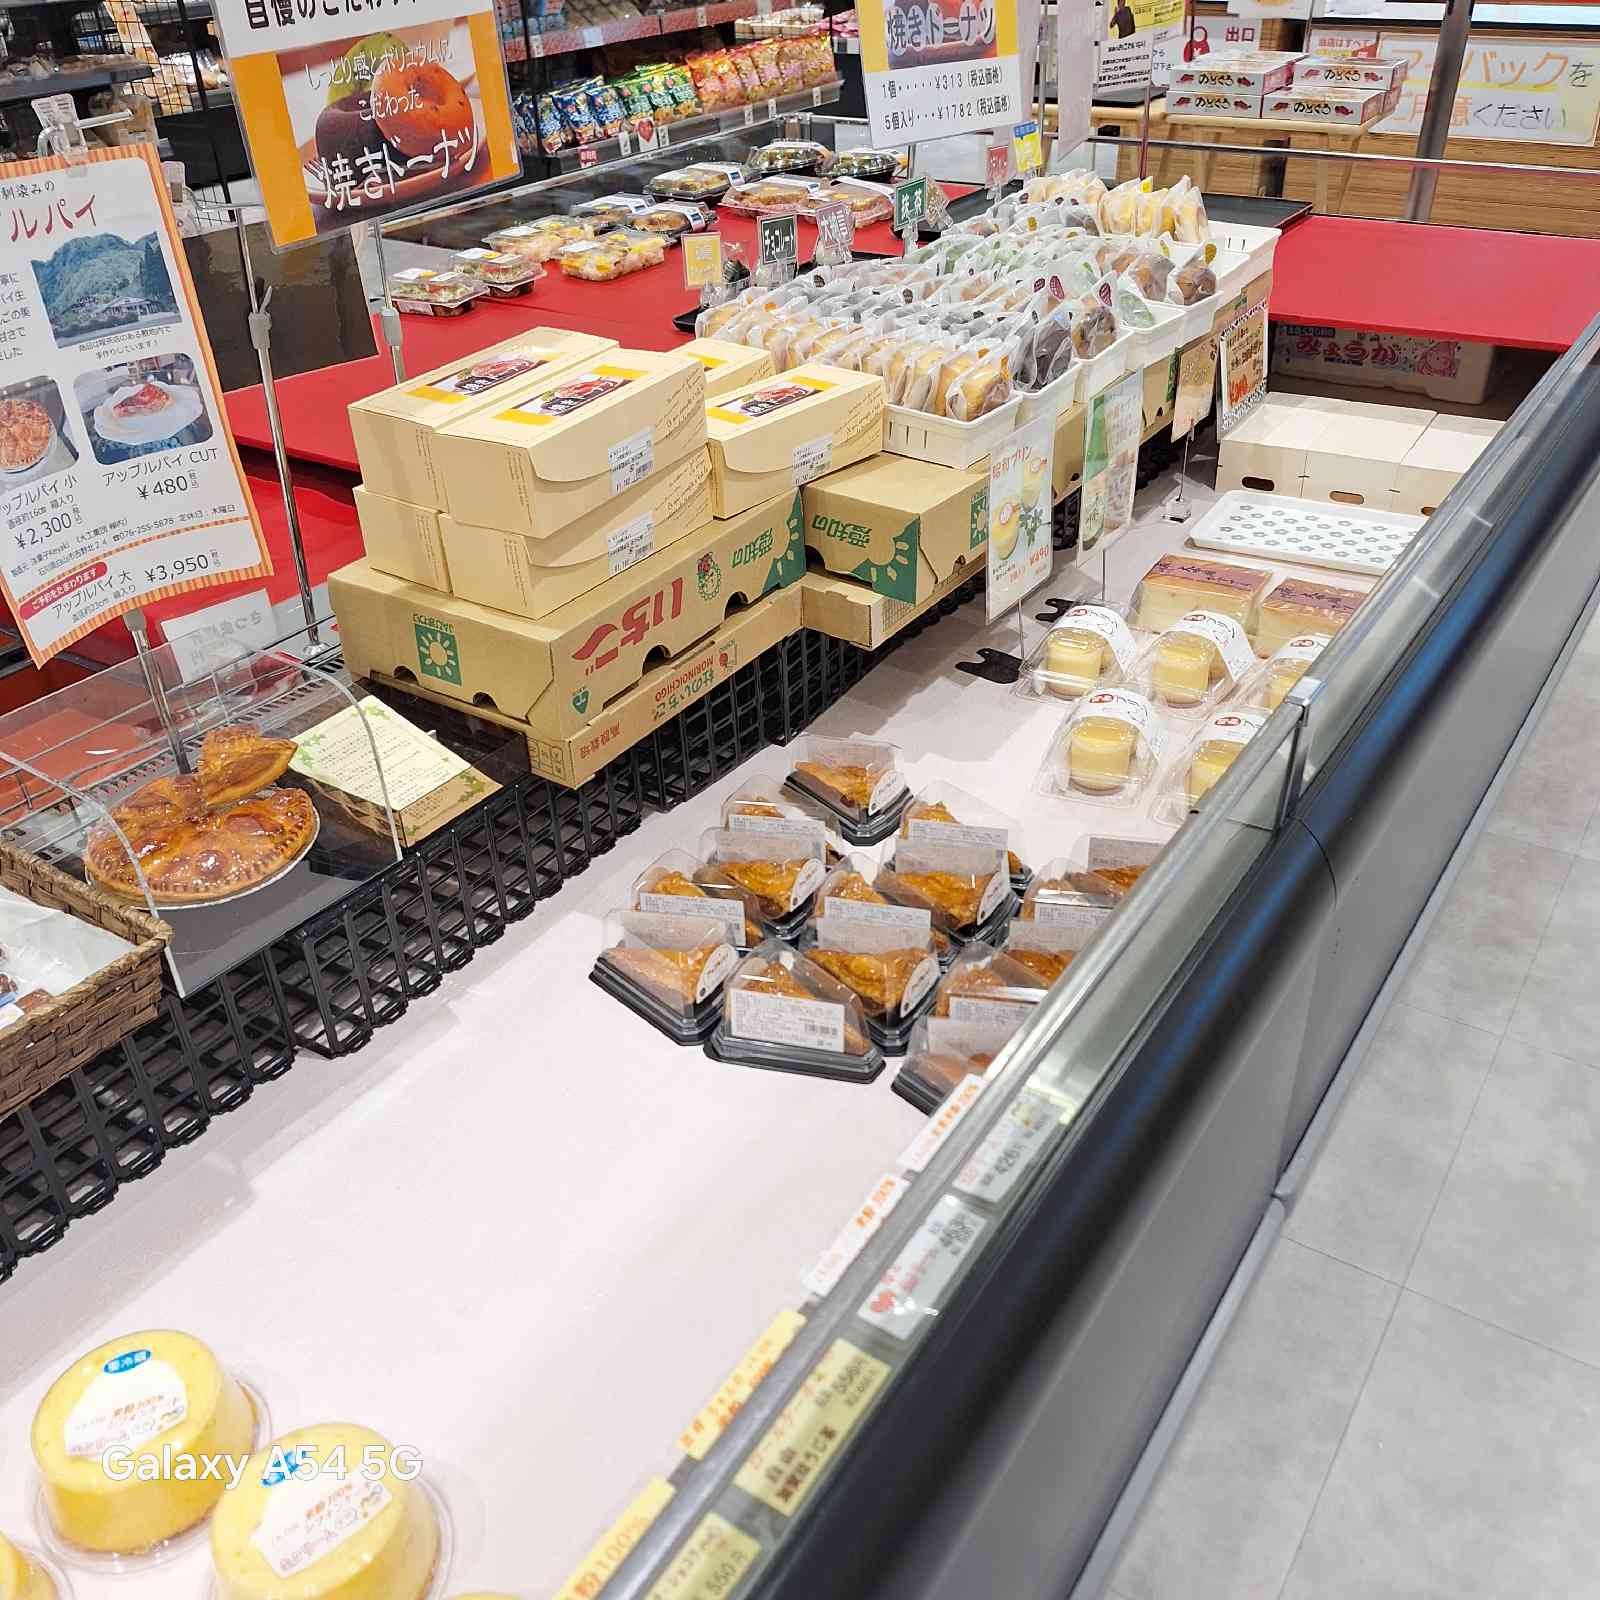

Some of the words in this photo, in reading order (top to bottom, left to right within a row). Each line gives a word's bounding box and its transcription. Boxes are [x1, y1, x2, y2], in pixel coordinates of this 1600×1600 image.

[886, 3, 994, 51] 焼きドーナツ
[1225, 27, 1255, 42] 出口
[359, 85, 424, 121] こだわった
[322, 122, 478, 211] 焼きドーナツ
[63, 473, 78, 489] 小
[102, 456, 184, 487] アップルパイ
[190, 448, 218, 463] CUT
[137, 475, 189, 499] ¥480
[15, 512, 72, 549] ¥2,300
[53, 575, 114, 619] アップルパイ
[120, 569, 133, 585] 大
[145, 554, 209, 583] ¥3,950
[572, 576, 684, 677] いちご
[654, 655, 714, 702] MORINOICHIGO
